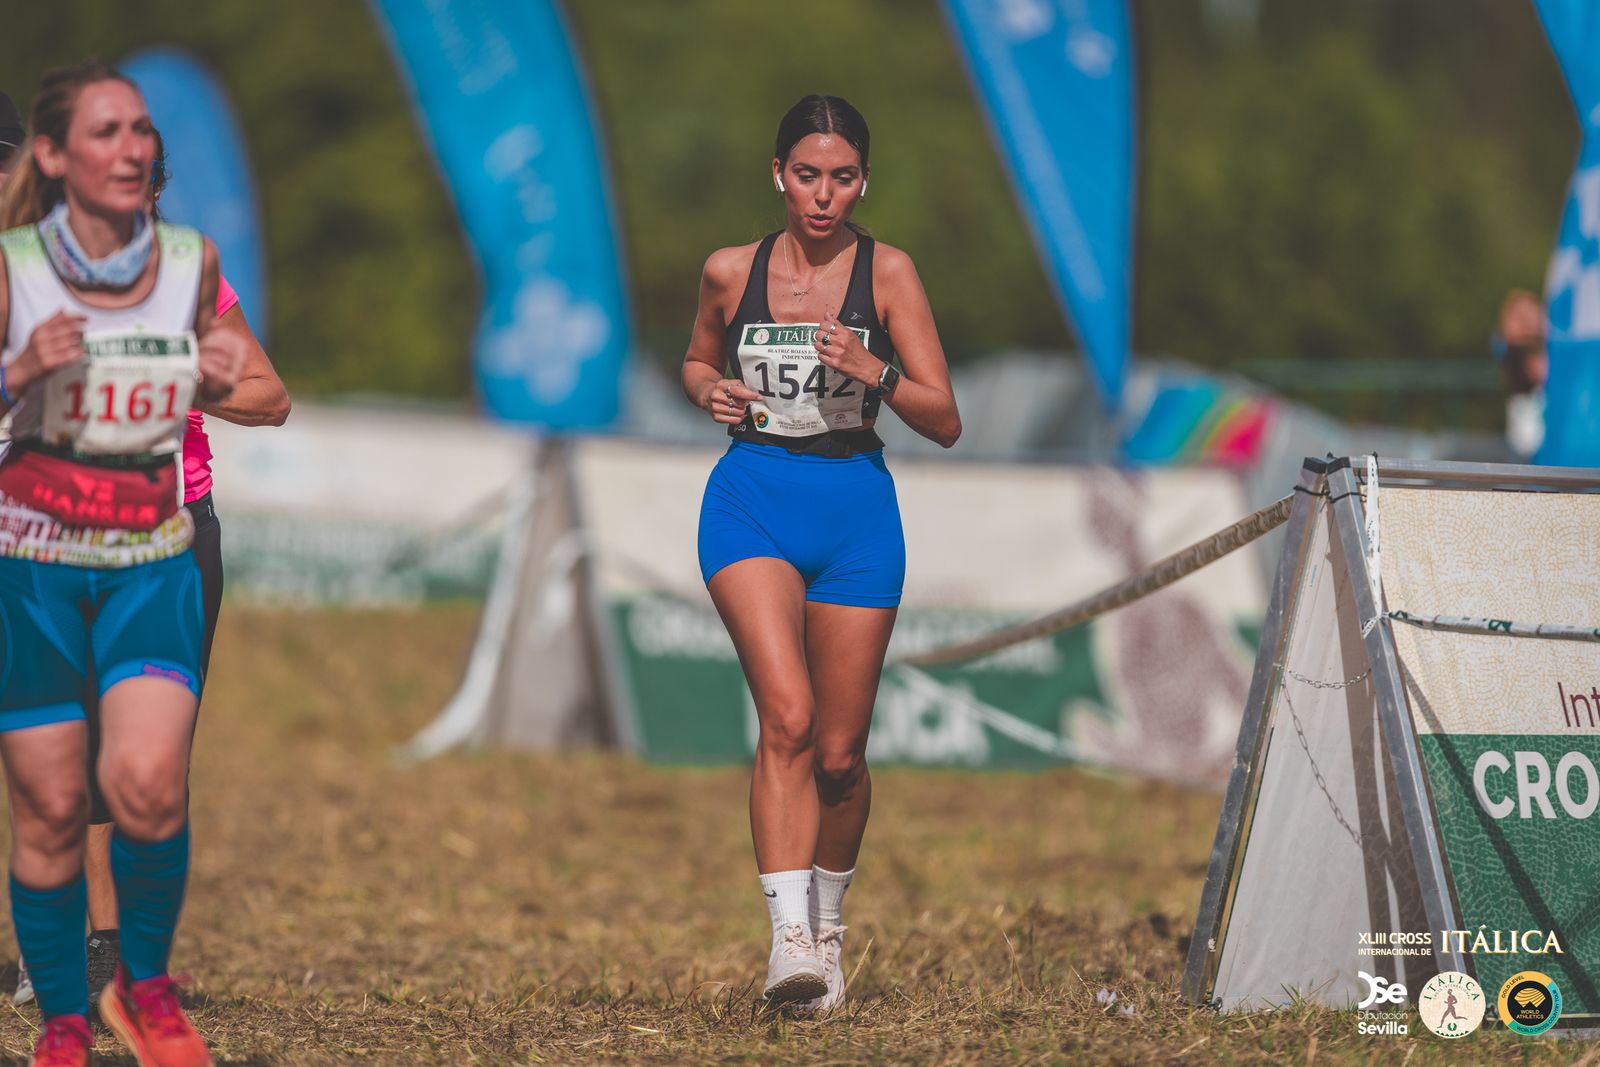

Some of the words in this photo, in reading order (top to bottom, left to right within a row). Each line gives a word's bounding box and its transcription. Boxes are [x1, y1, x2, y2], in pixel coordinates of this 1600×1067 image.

[776, 327, 817, 342] ITÁLI
[754, 361, 856, 400] 1542
[62, 381, 179, 426] 1161
[1472, 750, 1600, 820] CRO
